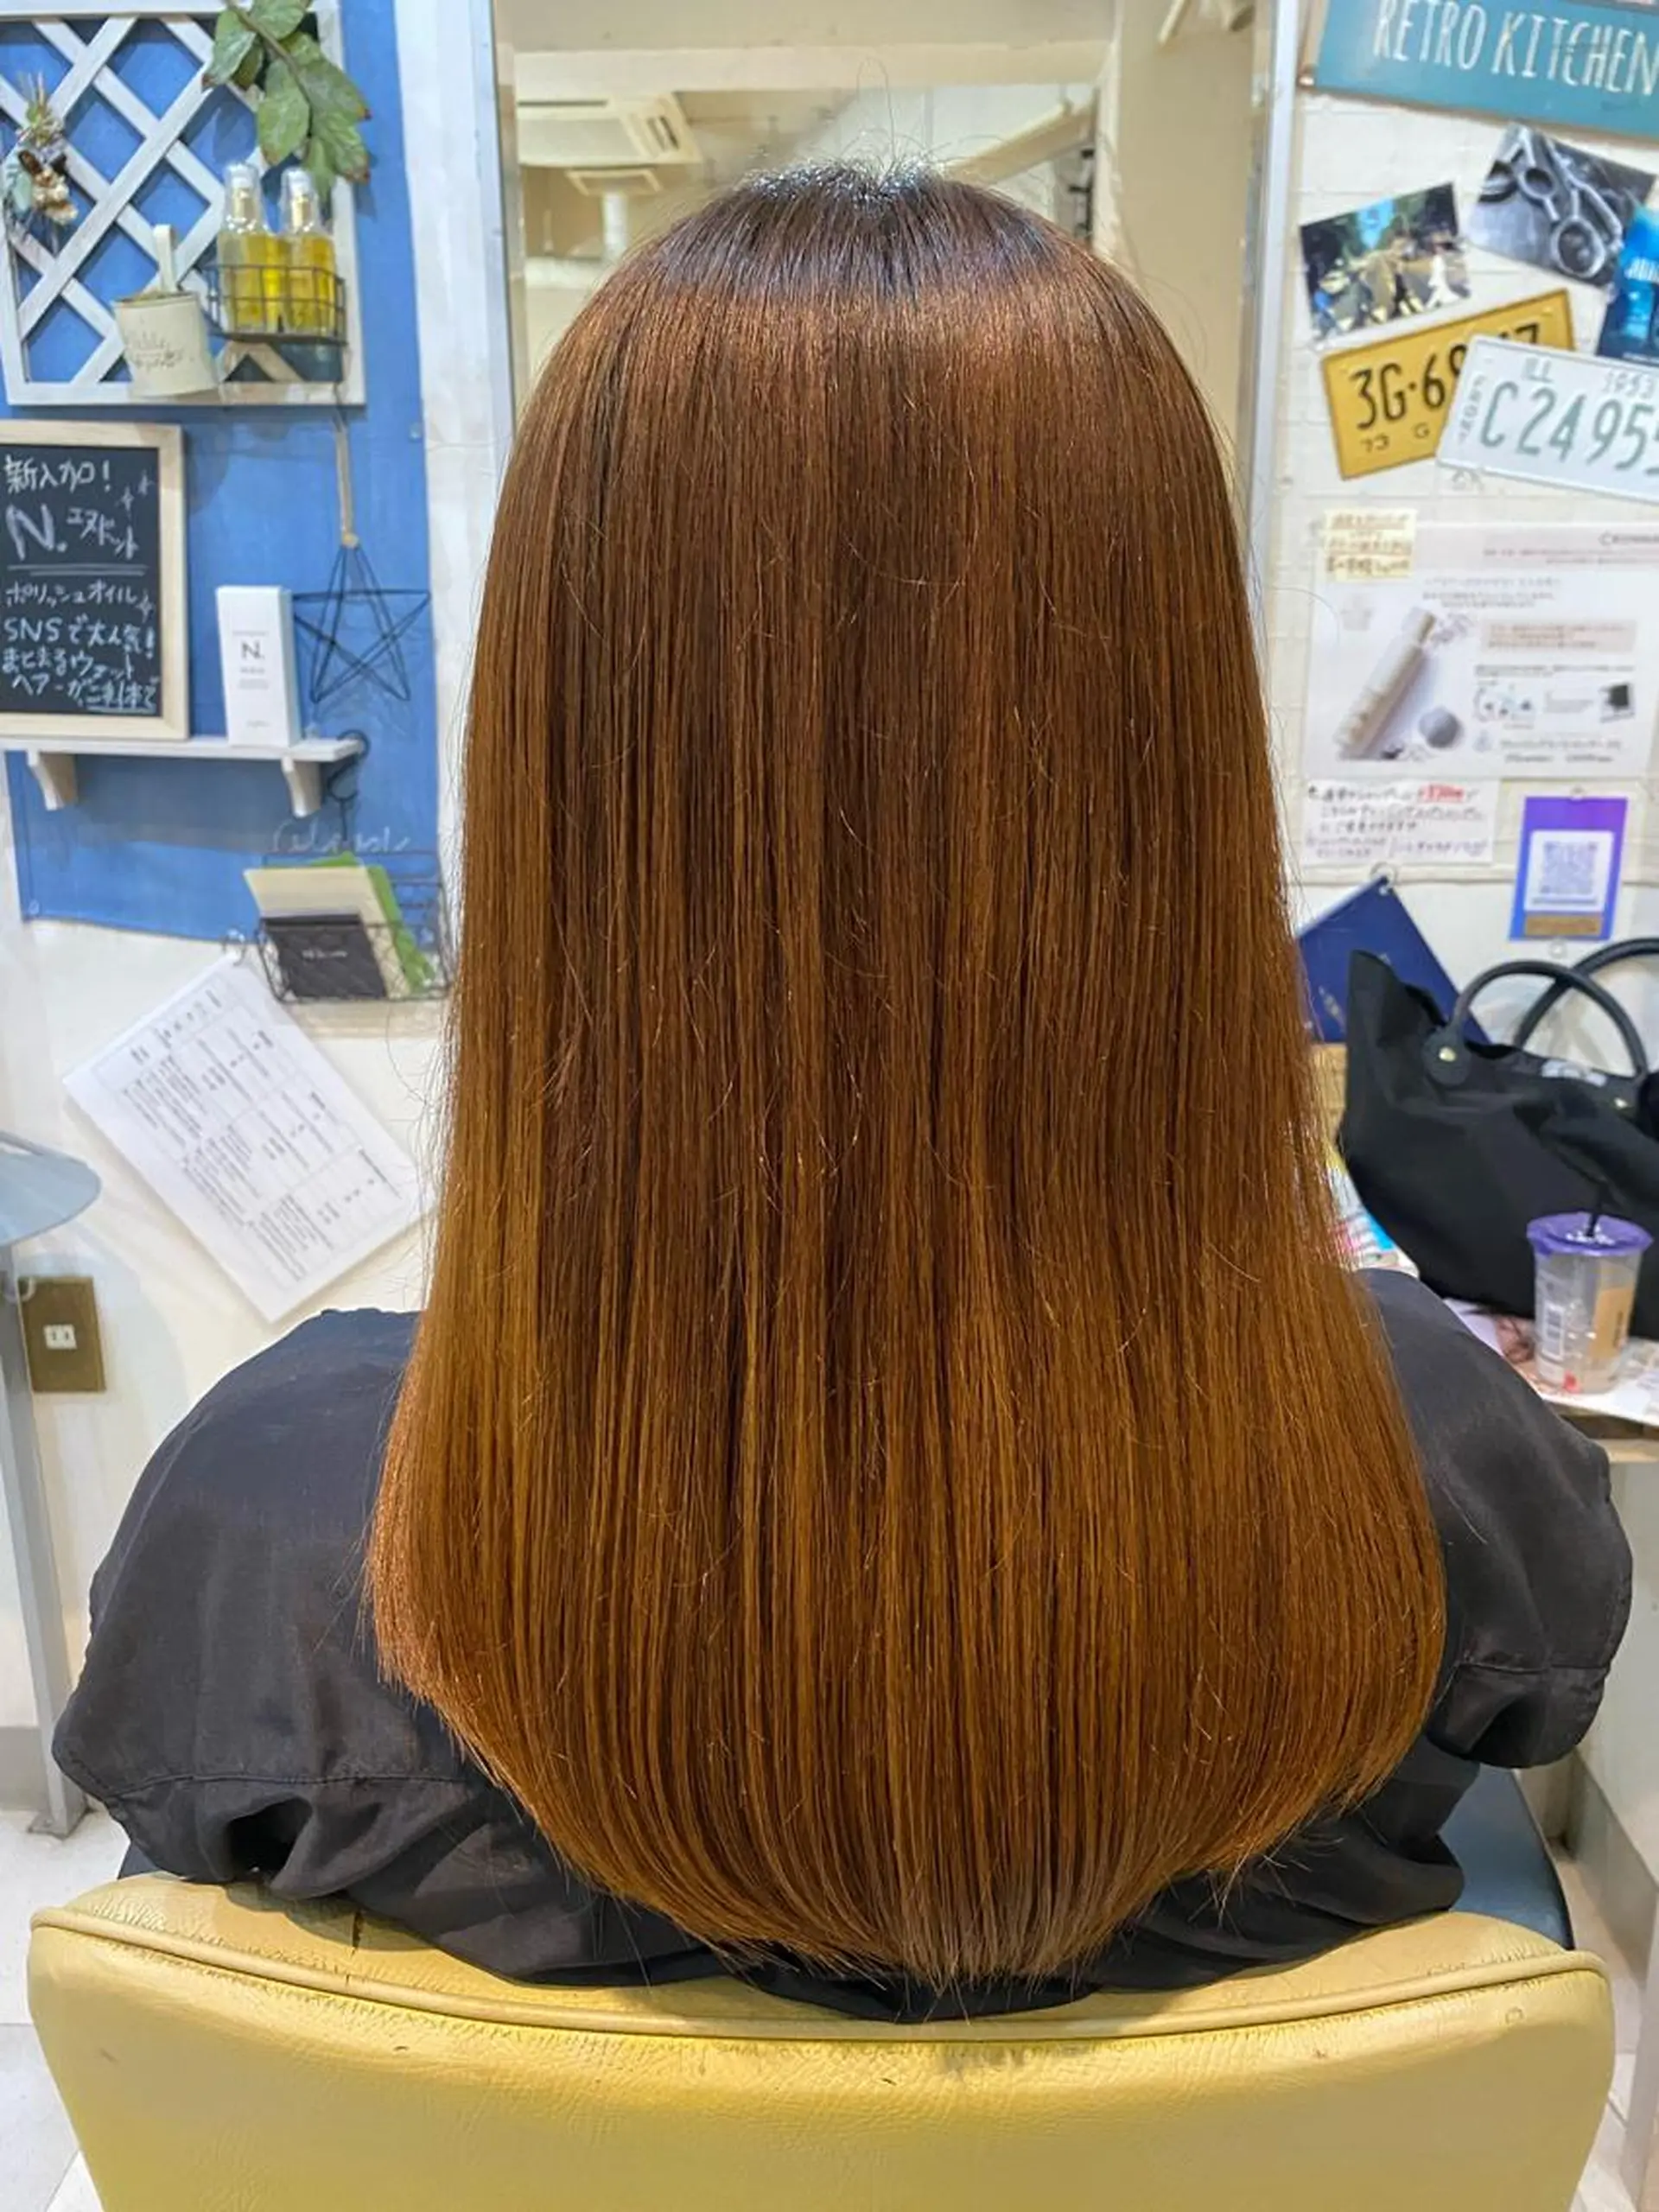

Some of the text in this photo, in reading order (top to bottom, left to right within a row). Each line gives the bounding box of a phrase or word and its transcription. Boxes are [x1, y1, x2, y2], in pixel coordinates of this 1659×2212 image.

[1372, 0, 1659, 97] RETRO KITCHEN
[6, 503, 68, 562] N.
[5, 581, 138, 610] ポリッシュオイル
